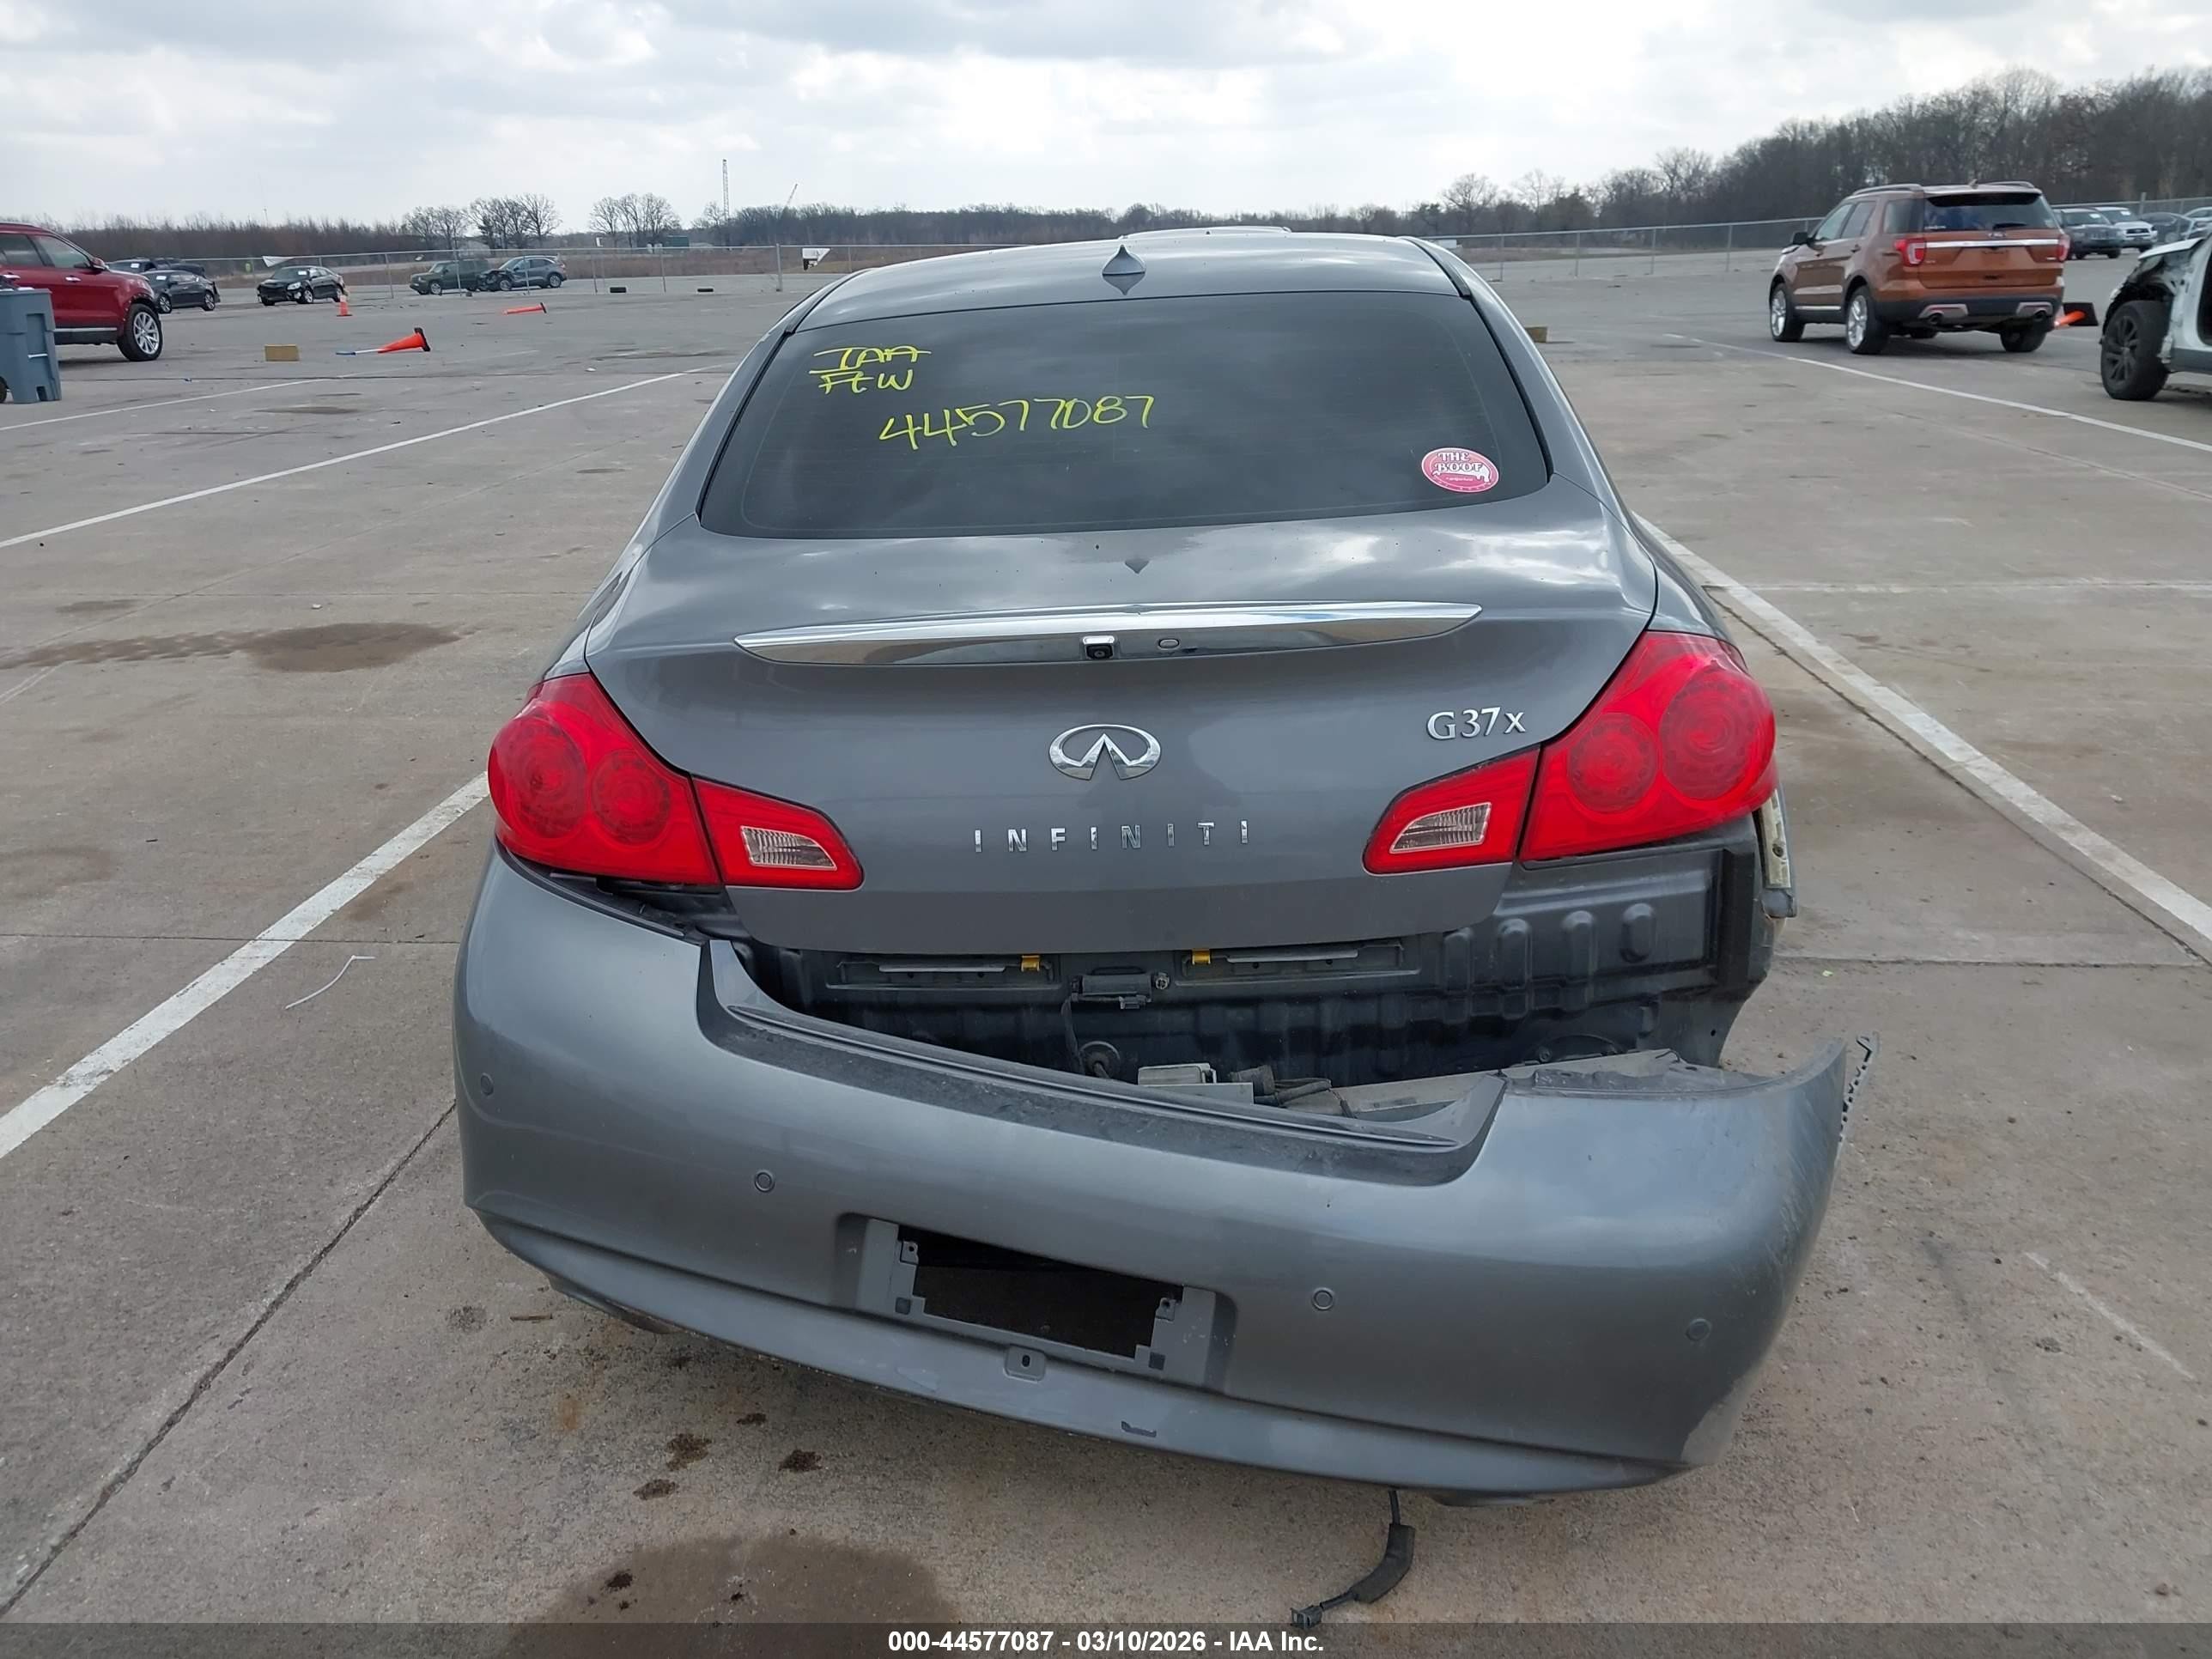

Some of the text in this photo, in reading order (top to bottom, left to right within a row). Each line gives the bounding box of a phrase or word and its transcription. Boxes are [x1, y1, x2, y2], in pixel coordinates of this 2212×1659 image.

[878, 394, 1155, 451] 44577087
[1437, 452, 1471, 462] THE
[974, 818, 1250, 854] INFINITI
